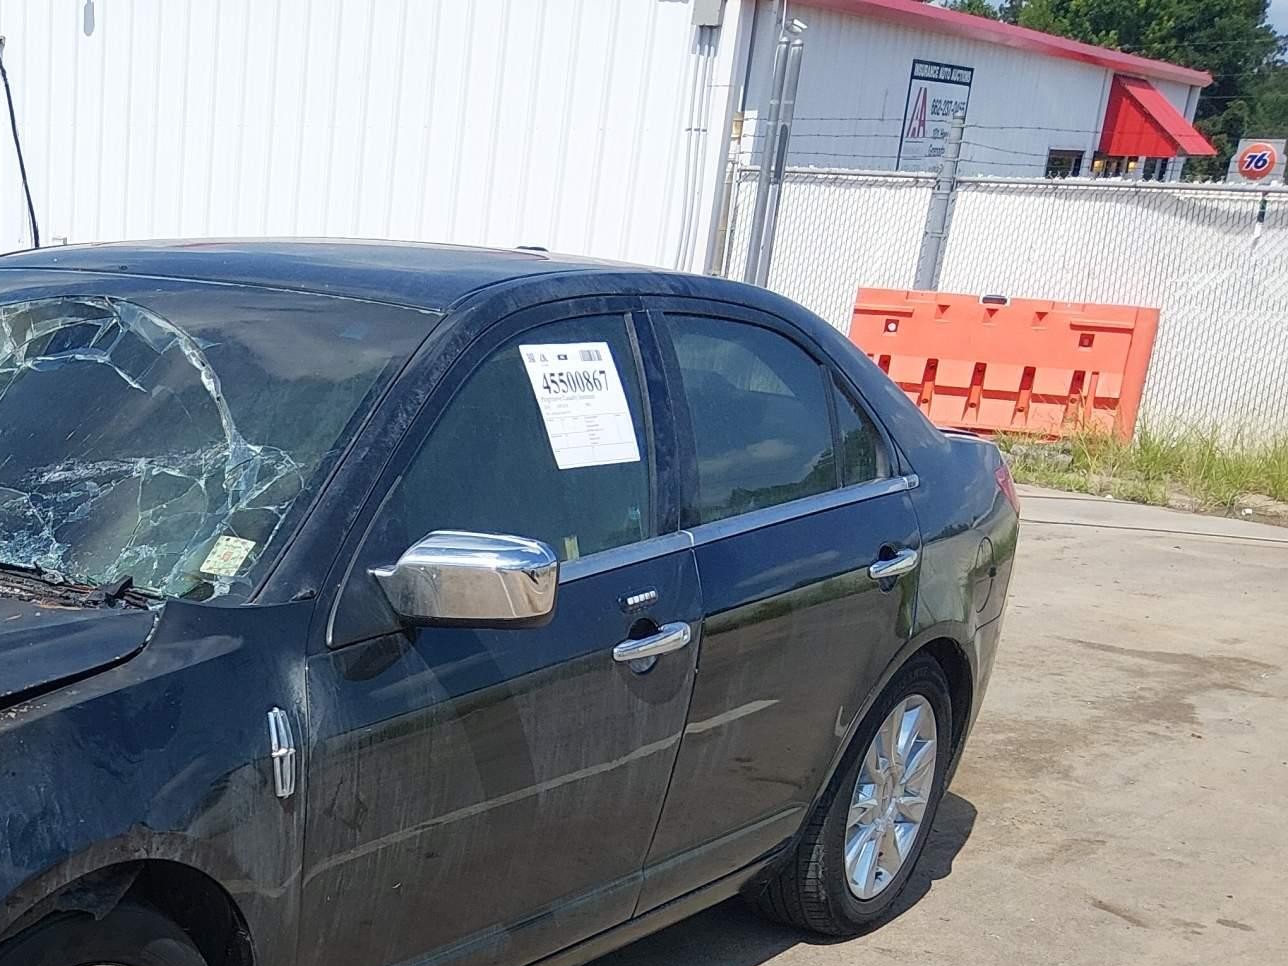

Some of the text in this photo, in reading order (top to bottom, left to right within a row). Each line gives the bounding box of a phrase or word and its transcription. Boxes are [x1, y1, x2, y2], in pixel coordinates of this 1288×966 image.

[939, 67, 951, 80] AUTO
[1242, 150, 1272, 171] 76
[543, 370, 608, 395] 45500867
